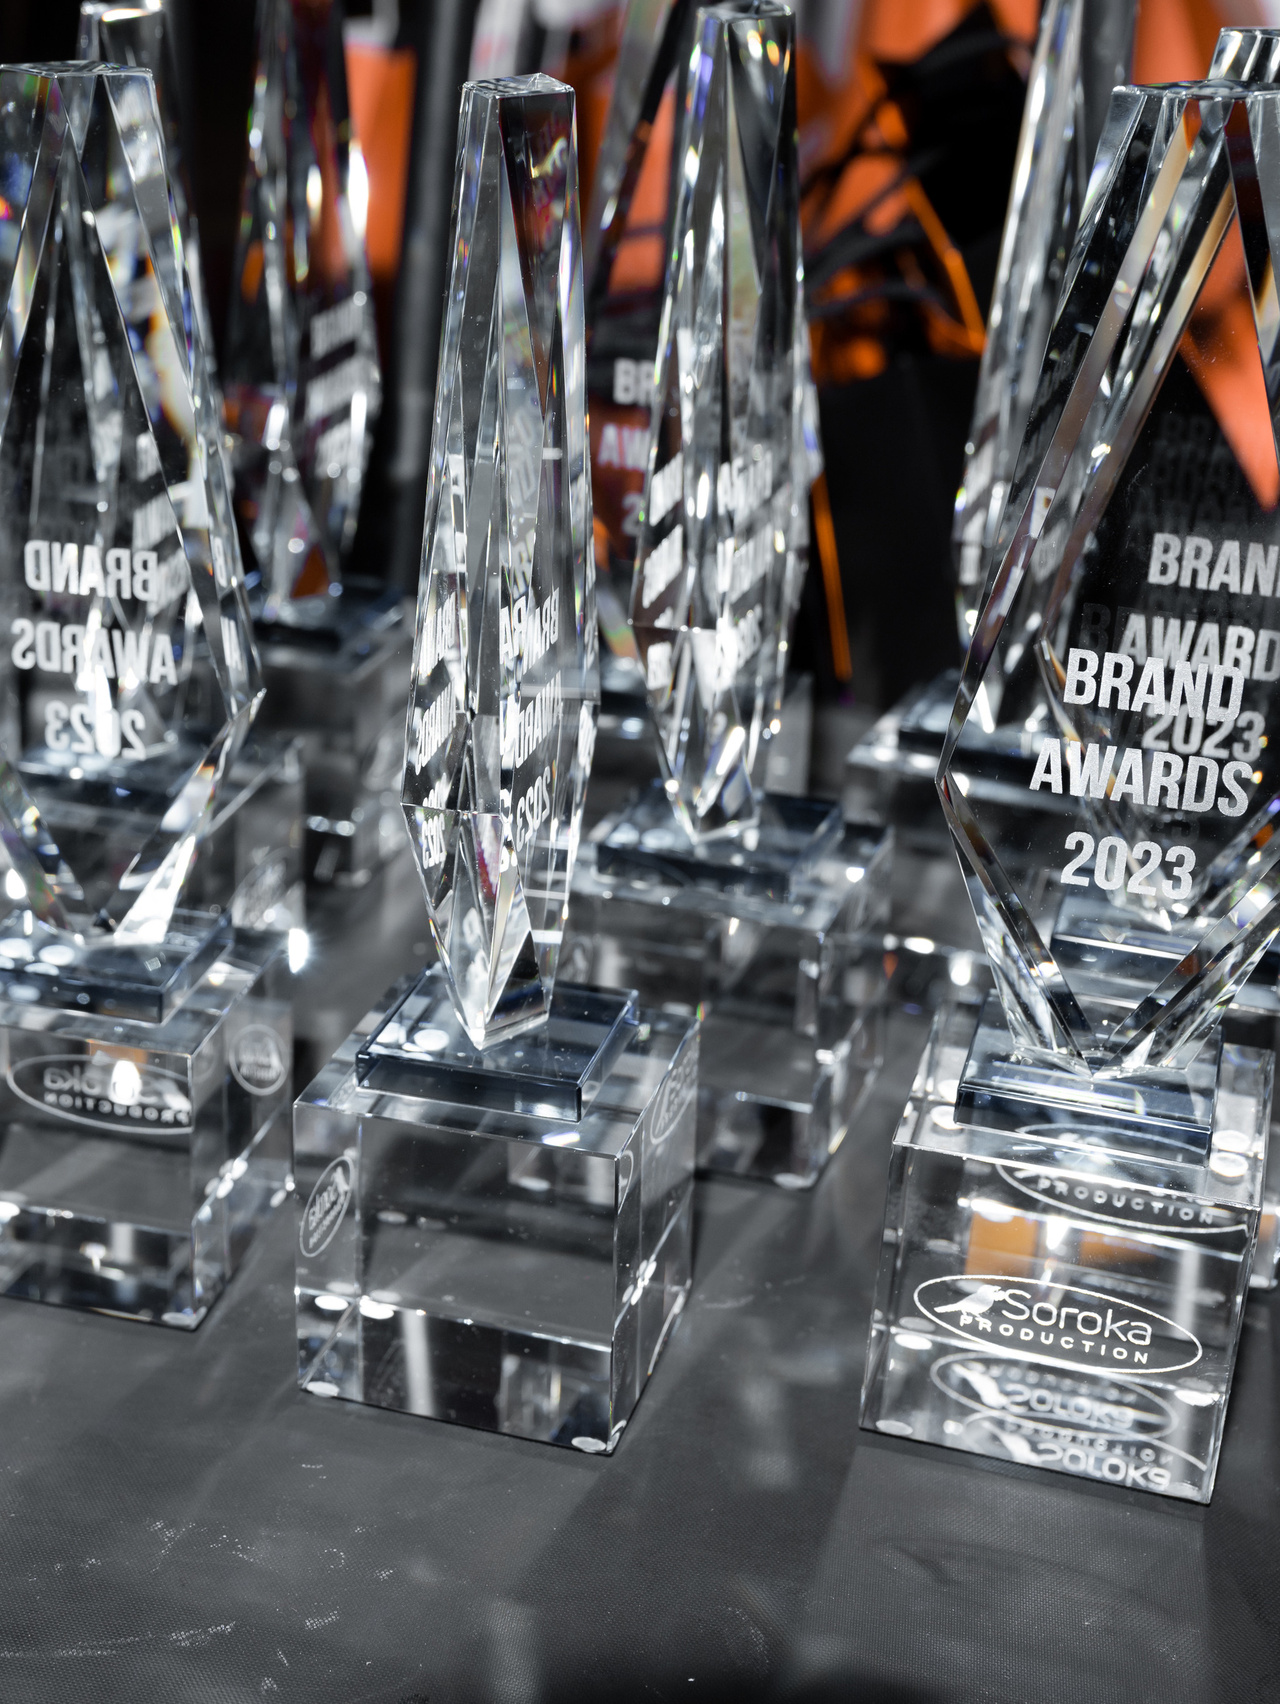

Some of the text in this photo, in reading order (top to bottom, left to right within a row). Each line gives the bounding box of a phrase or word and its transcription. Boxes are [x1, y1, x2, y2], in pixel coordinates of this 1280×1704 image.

[1147, 532, 1280, 600] BRAN
[1062, 646, 1246, 723] BRAND
[1028, 738, 1255, 818] AWARDS
[1059, 831, 1197, 901] 2023
[960, 1313, 1150, 1365] PRODUCTION
[1001, 1288, 1153, 1347] Soroka
